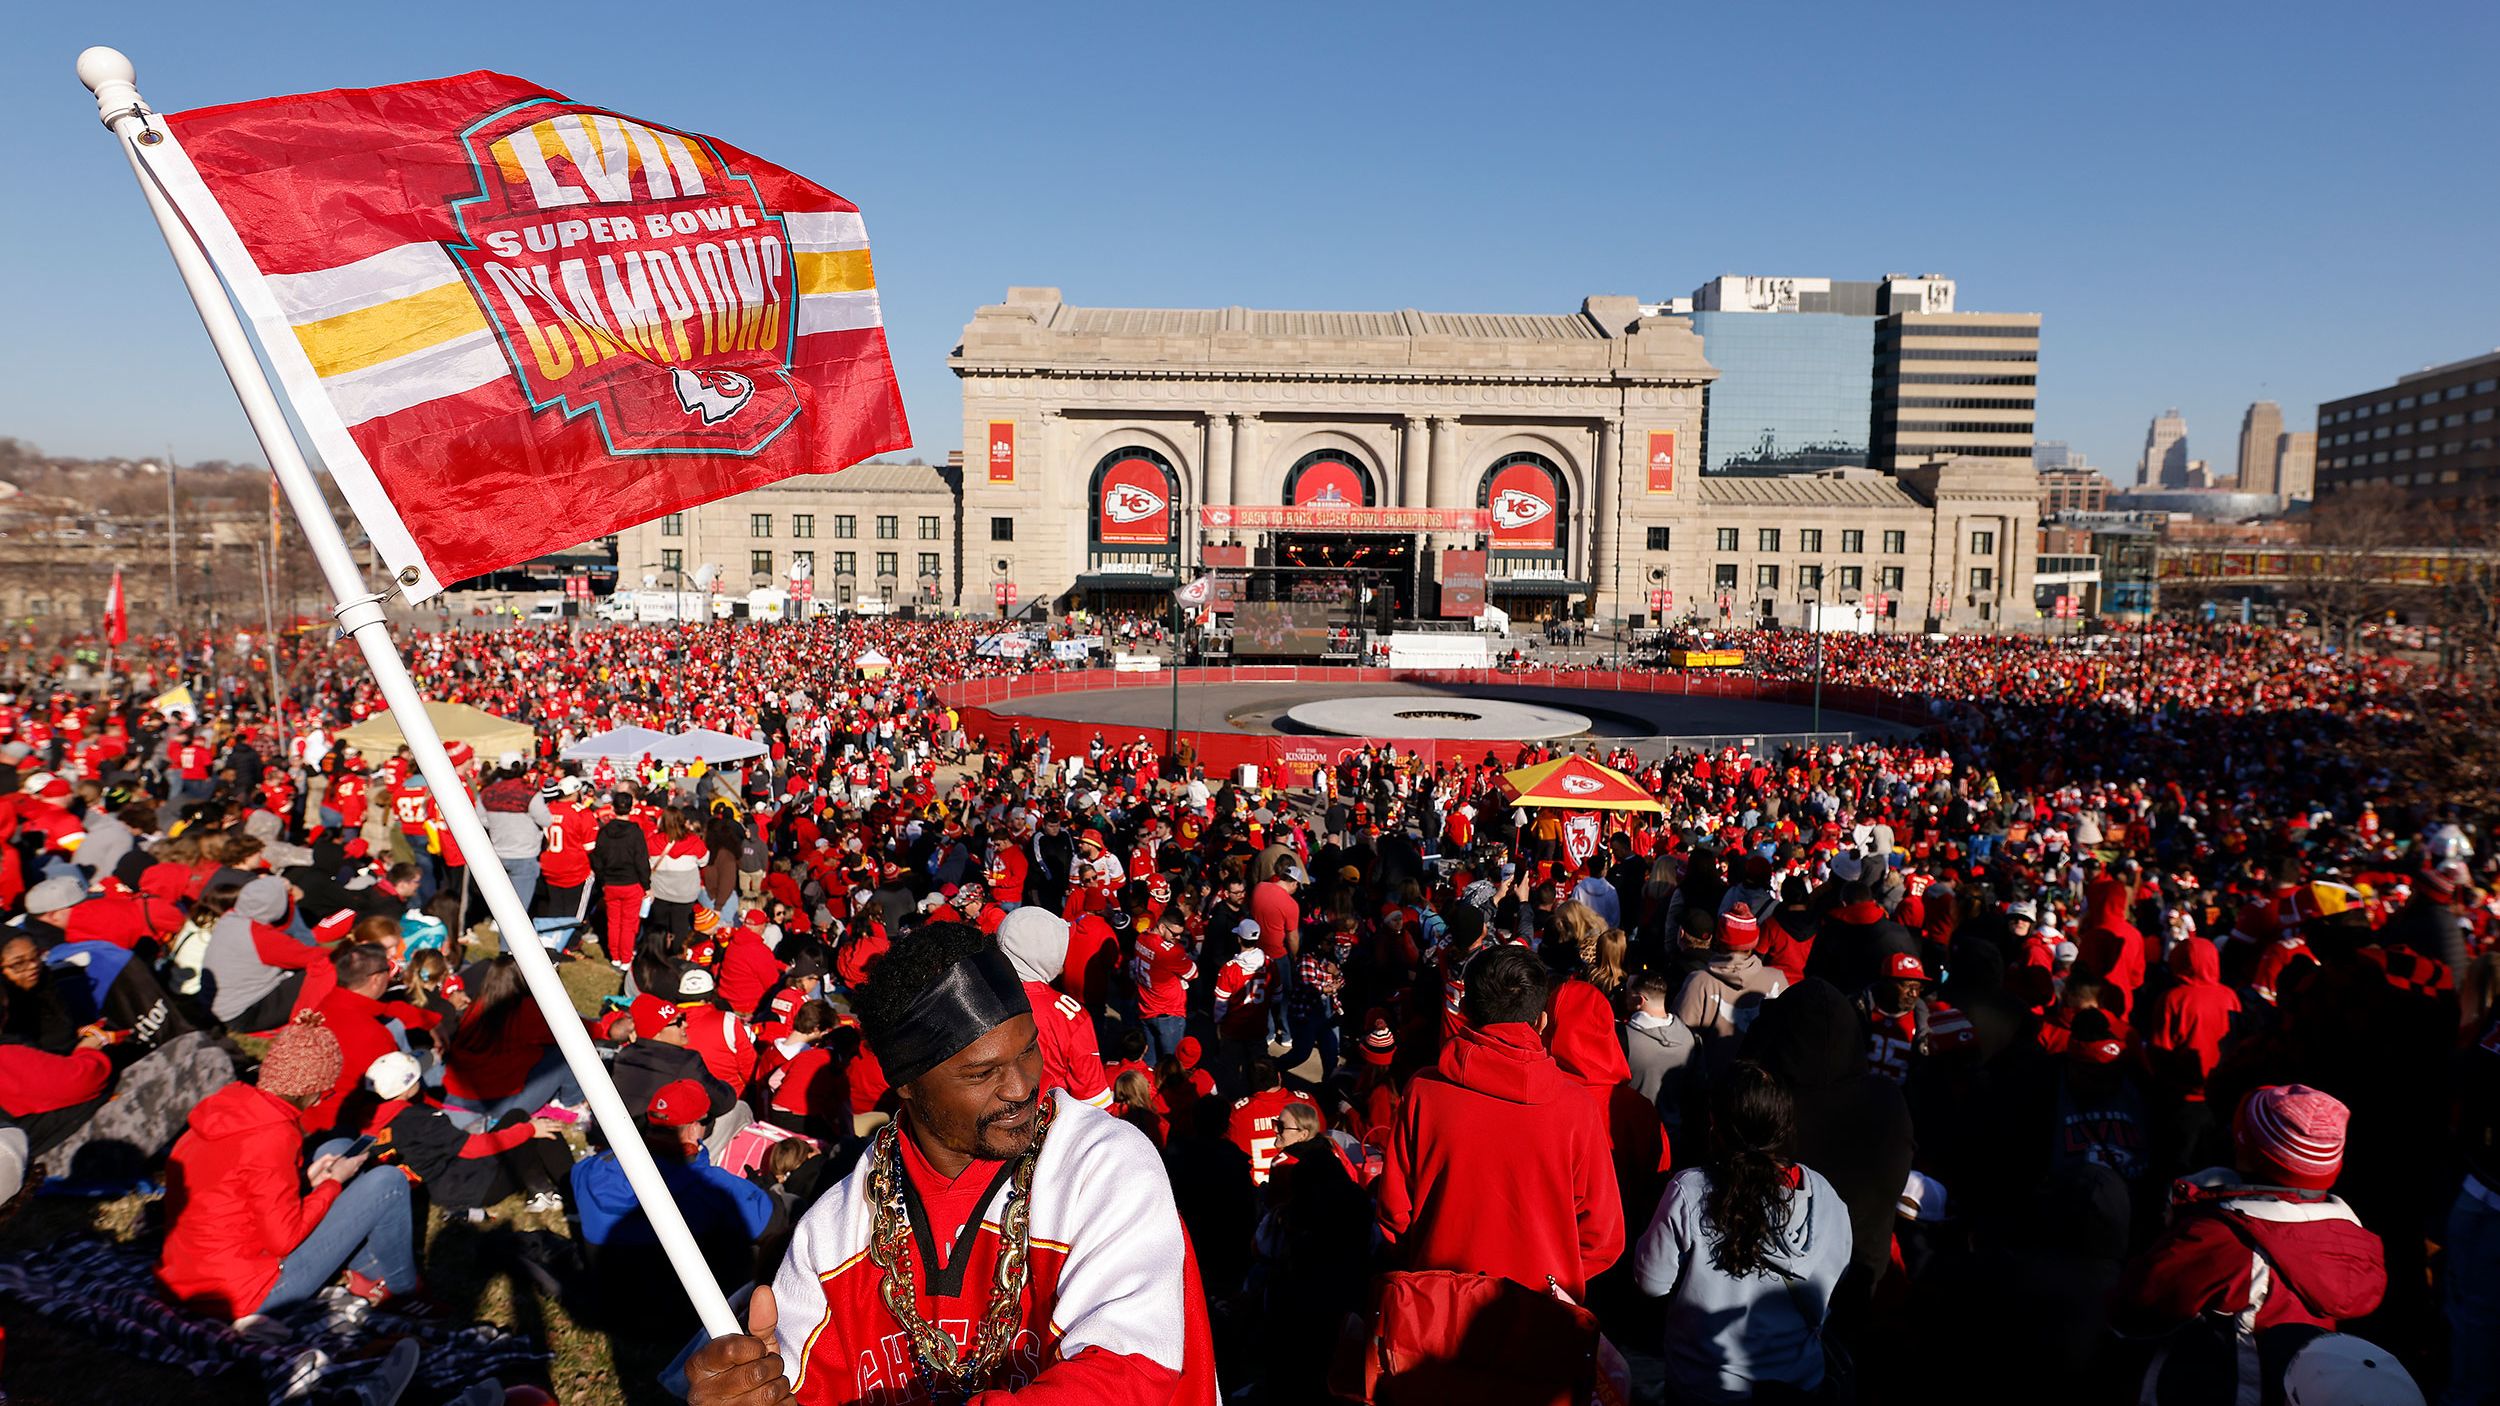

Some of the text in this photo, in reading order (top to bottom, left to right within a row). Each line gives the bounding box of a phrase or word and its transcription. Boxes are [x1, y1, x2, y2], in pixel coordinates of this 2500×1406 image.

[507, 114, 707, 209] LVII
[486, 205, 756, 258] SUPER BOWL
[1120, 493, 1150, 513] KC
[1507, 498, 1537, 517] KC
[1317, 513, 1347, 525] SUPER
[1350, 513, 1379, 526] BOWL
[1383, 513, 1442, 527] CHAMPIONS
[1286, 752, 1327, 762] KINGDOM
[856, 767, 868, 780] 15
[397, 796, 426, 822] 87
[1243, 978, 1266, 1005] 15
[658, 1004, 675, 1019] KC
[1054, 994, 1082, 1021] 10
